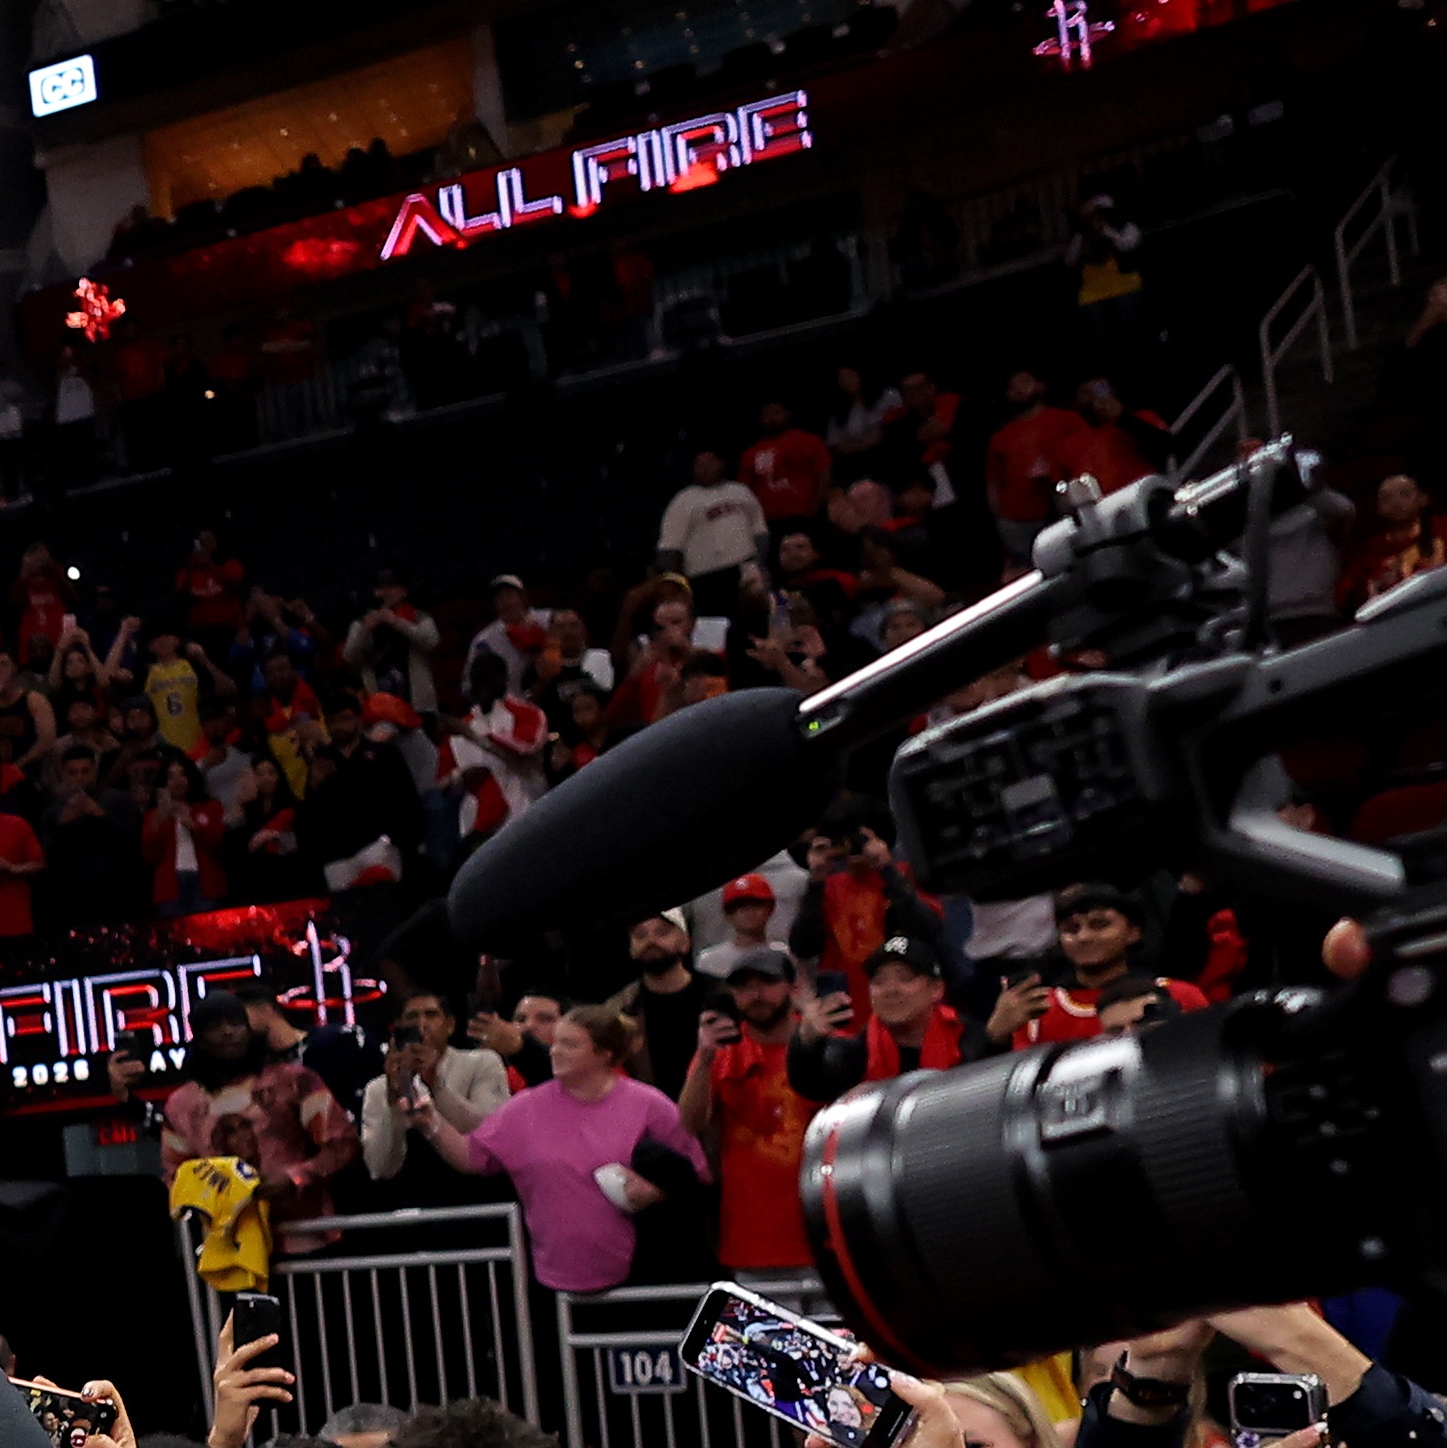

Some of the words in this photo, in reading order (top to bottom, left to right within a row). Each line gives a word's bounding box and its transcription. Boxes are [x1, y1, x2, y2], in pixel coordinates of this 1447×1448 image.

[380, 168, 564, 261] ALL
[571, 90, 813, 210] FIRE
[11, 1058, 90, 1088] 2026
[620, 1349, 673, 1385] 104
